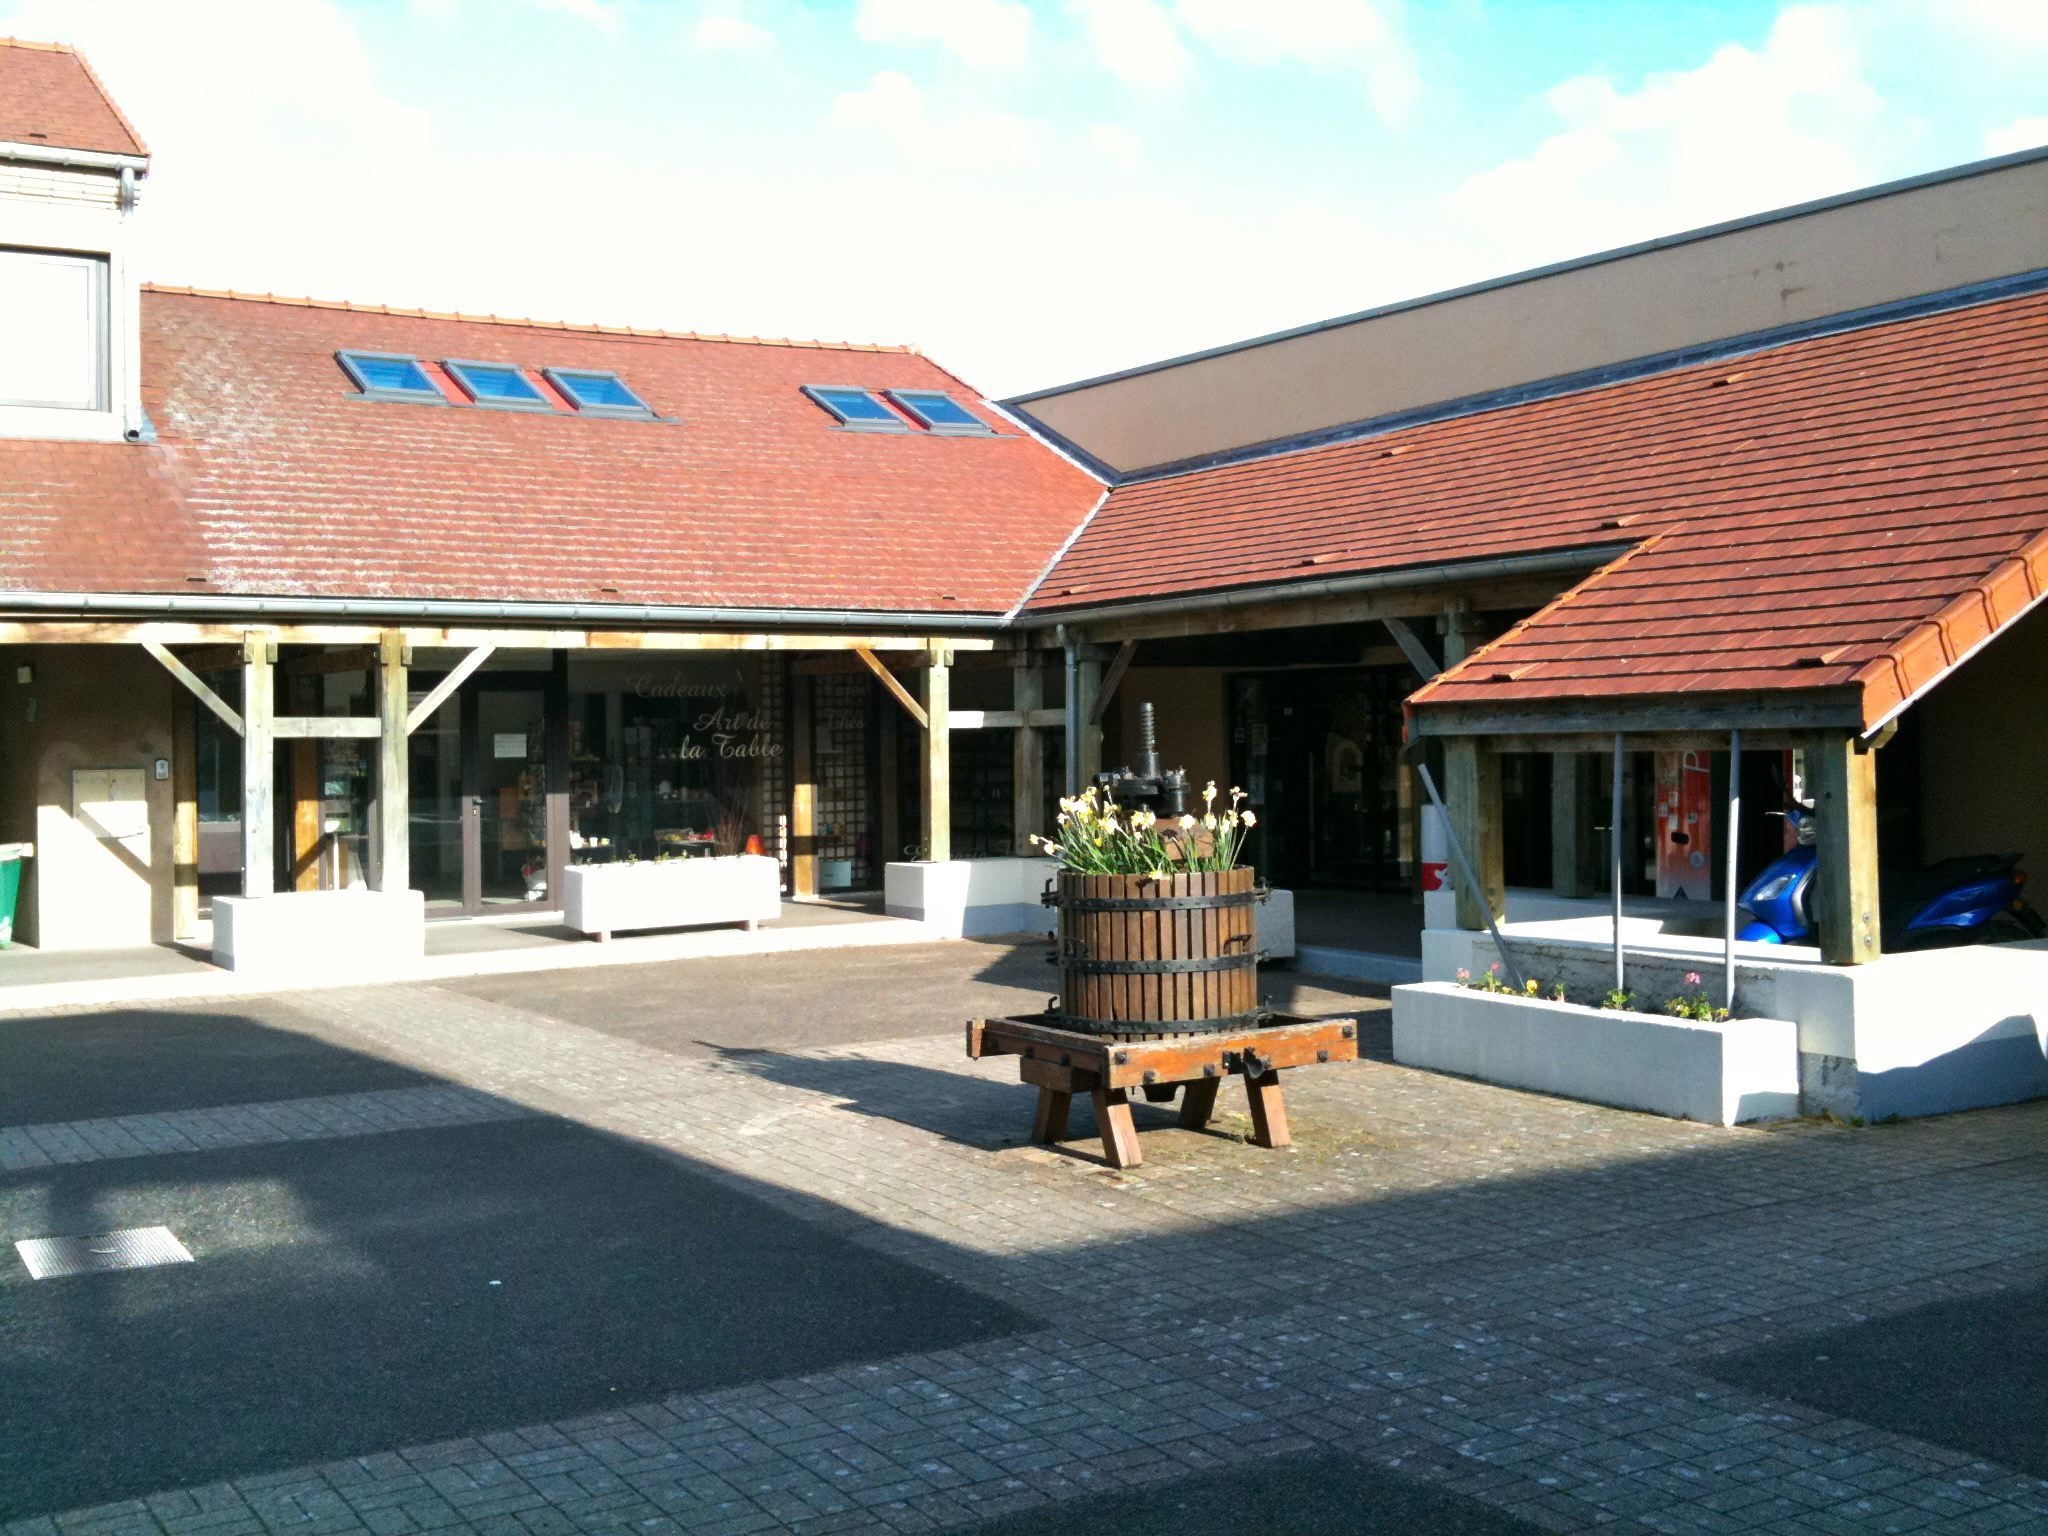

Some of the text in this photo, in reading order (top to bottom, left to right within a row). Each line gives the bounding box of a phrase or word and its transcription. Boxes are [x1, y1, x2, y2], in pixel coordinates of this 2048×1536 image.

[632, 672, 728, 698] Cadeaux
[693, 706, 771, 731] Art de
[680, 733, 783, 759] la Table
